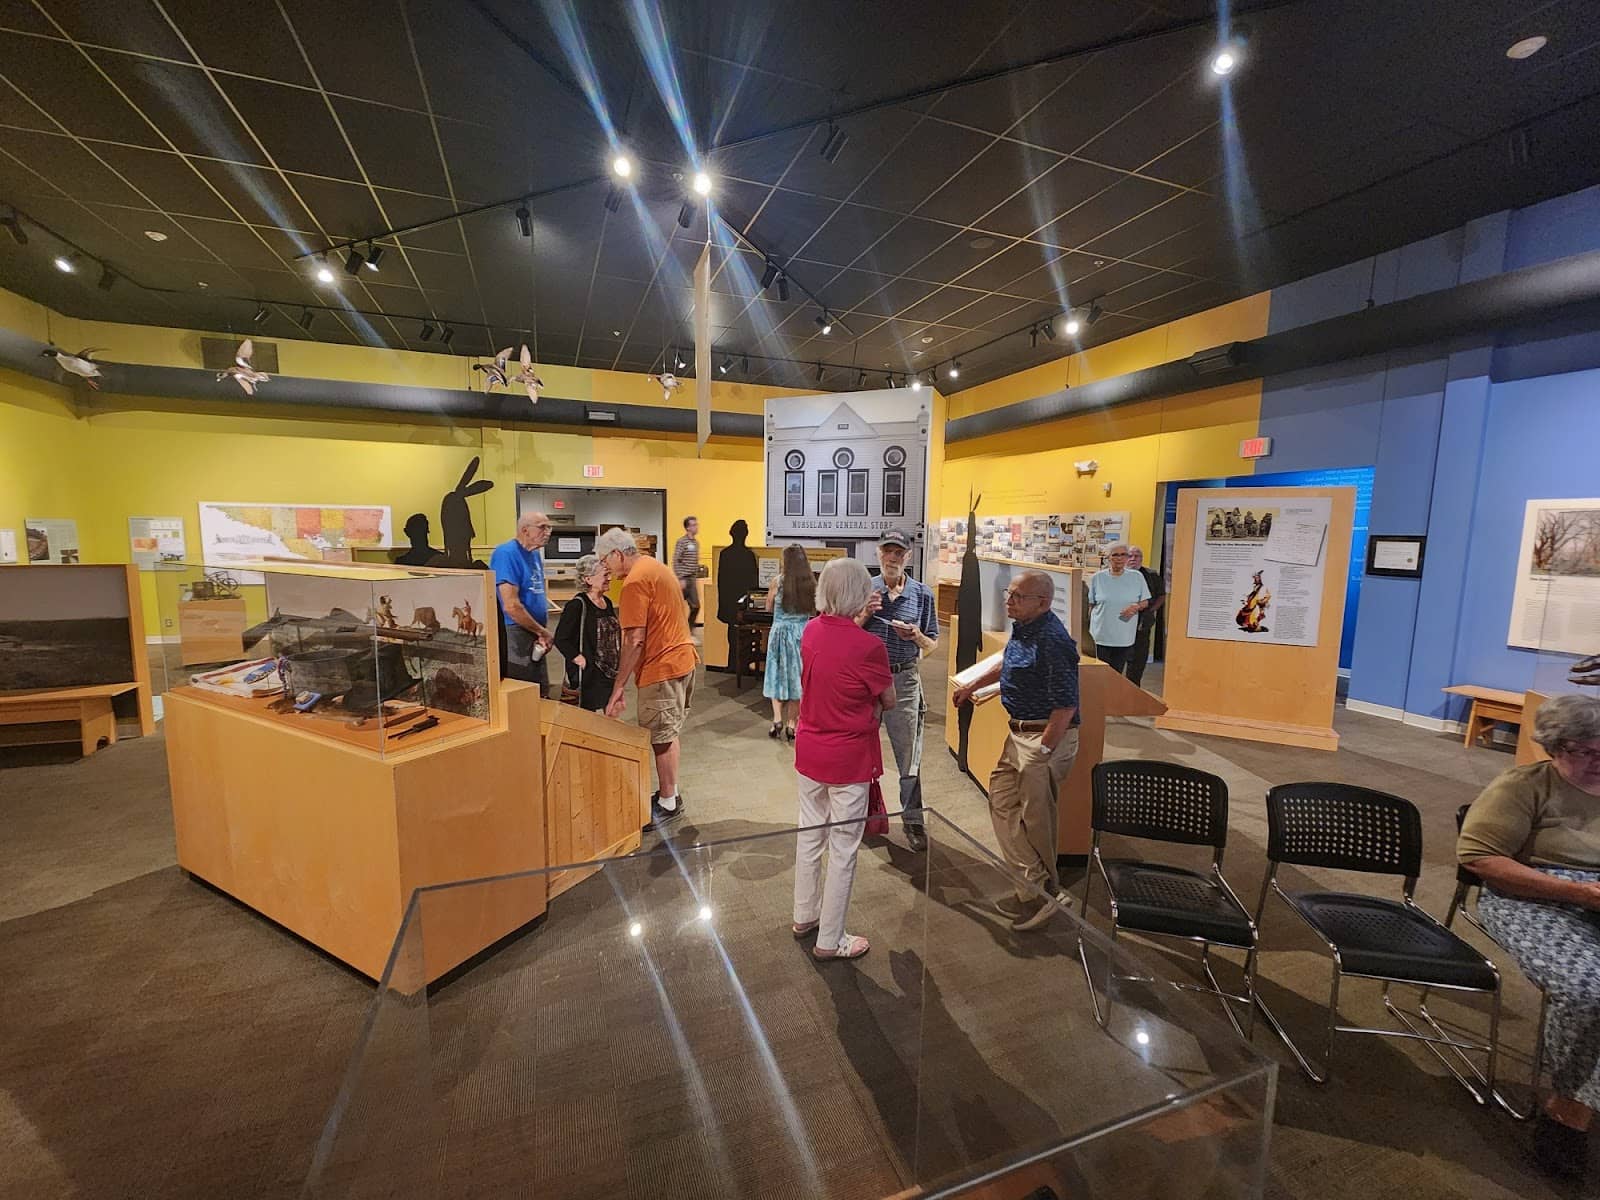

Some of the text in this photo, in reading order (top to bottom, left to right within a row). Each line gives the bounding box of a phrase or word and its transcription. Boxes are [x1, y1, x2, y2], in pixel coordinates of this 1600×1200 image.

[587, 466, 600, 476] EXIT
[835, 520, 867, 529] GENERAL
[870, 521, 893, 530] STORE
